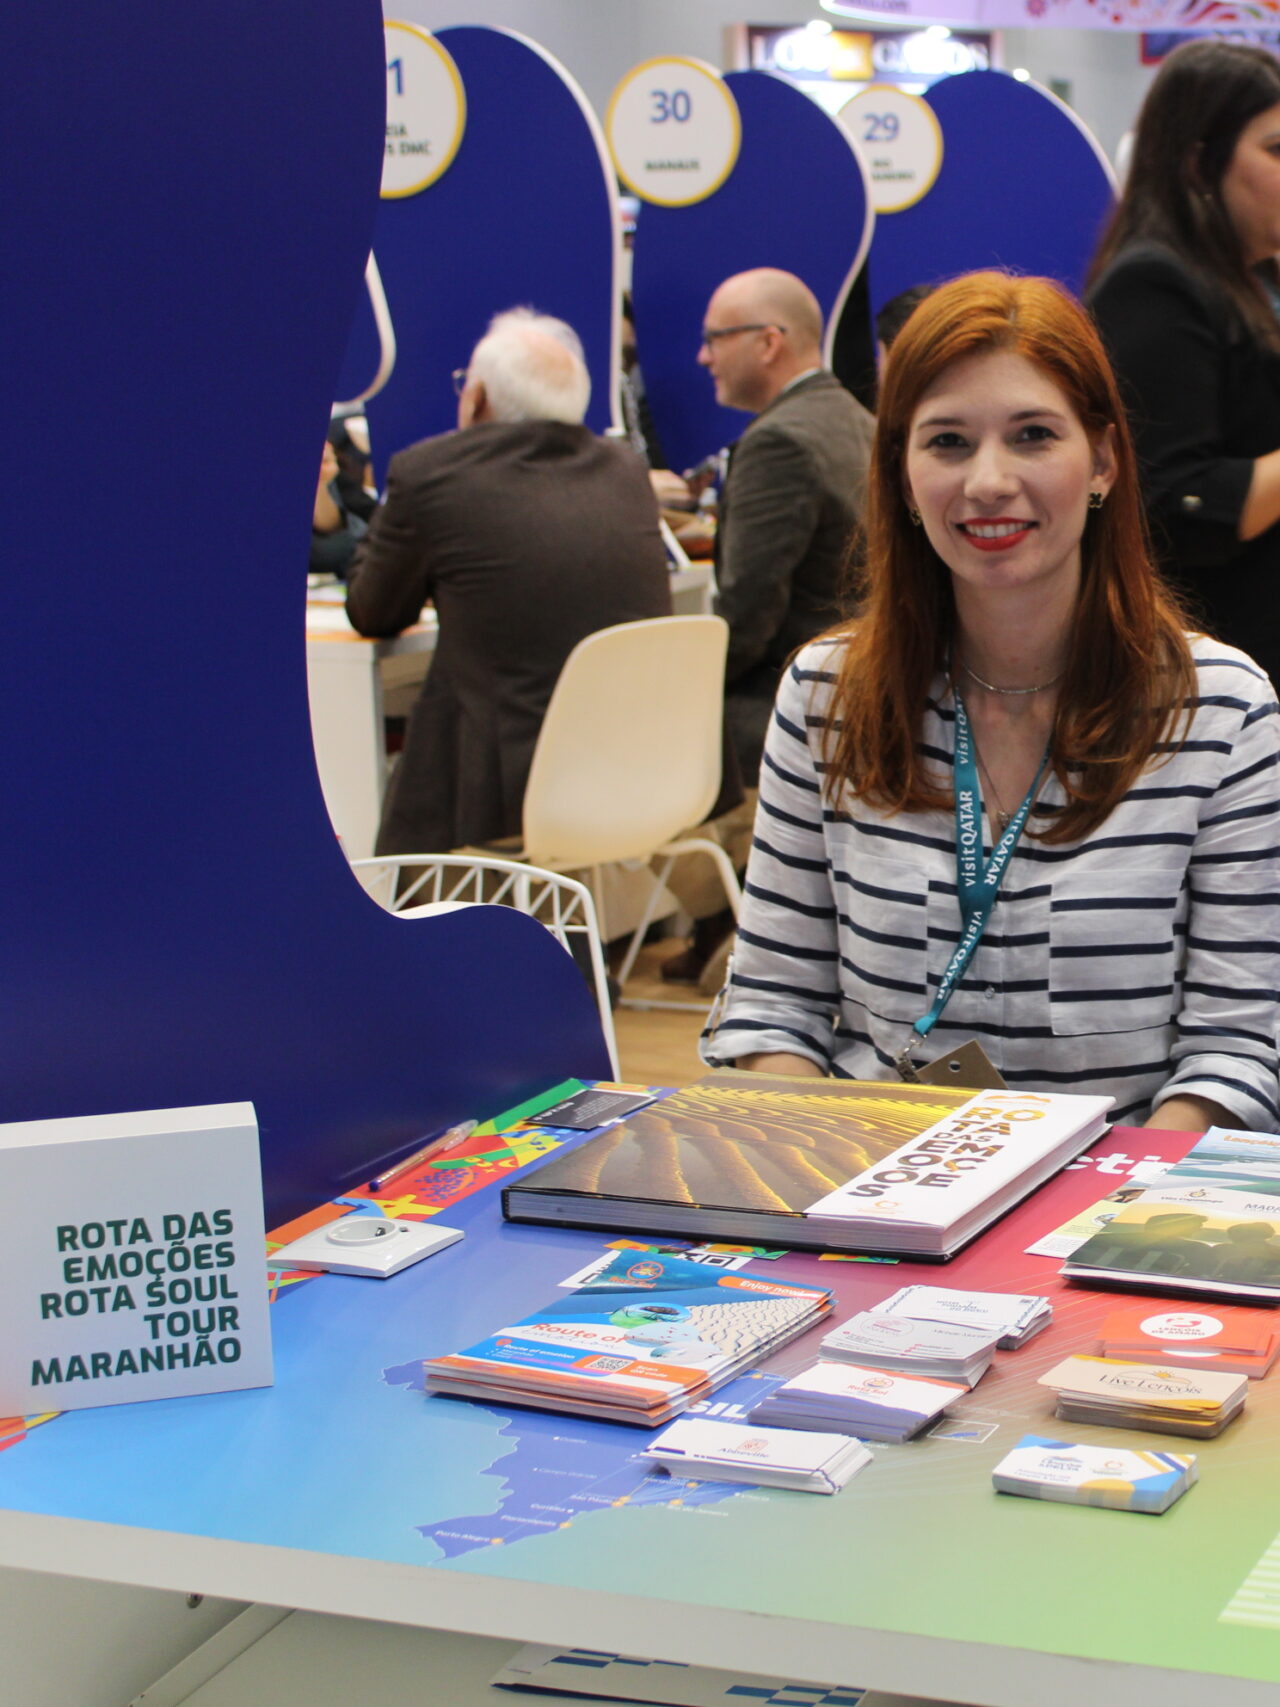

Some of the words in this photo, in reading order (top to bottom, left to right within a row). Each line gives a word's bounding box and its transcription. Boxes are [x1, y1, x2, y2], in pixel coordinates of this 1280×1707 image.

[650, 90, 691, 124] 30
[863, 112, 900, 142] 29
[57, 1216, 153, 1253] ROTA
[163, 1208, 234, 1241] DAS
[62, 1239, 236, 1286] EMOÇÕES
[40, 1283, 137, 1320] ROTA
[147, 1273, 239, 1308] SOUL
[739, 1279, 774, 1292] Enjoy
[144, 1305, 240, 1341] TOUR
[531, 1323, 597, 1339] Route
[601, 1333, 629, 1344] of
[31, 1334, 242, 1386] MARANHÃO
